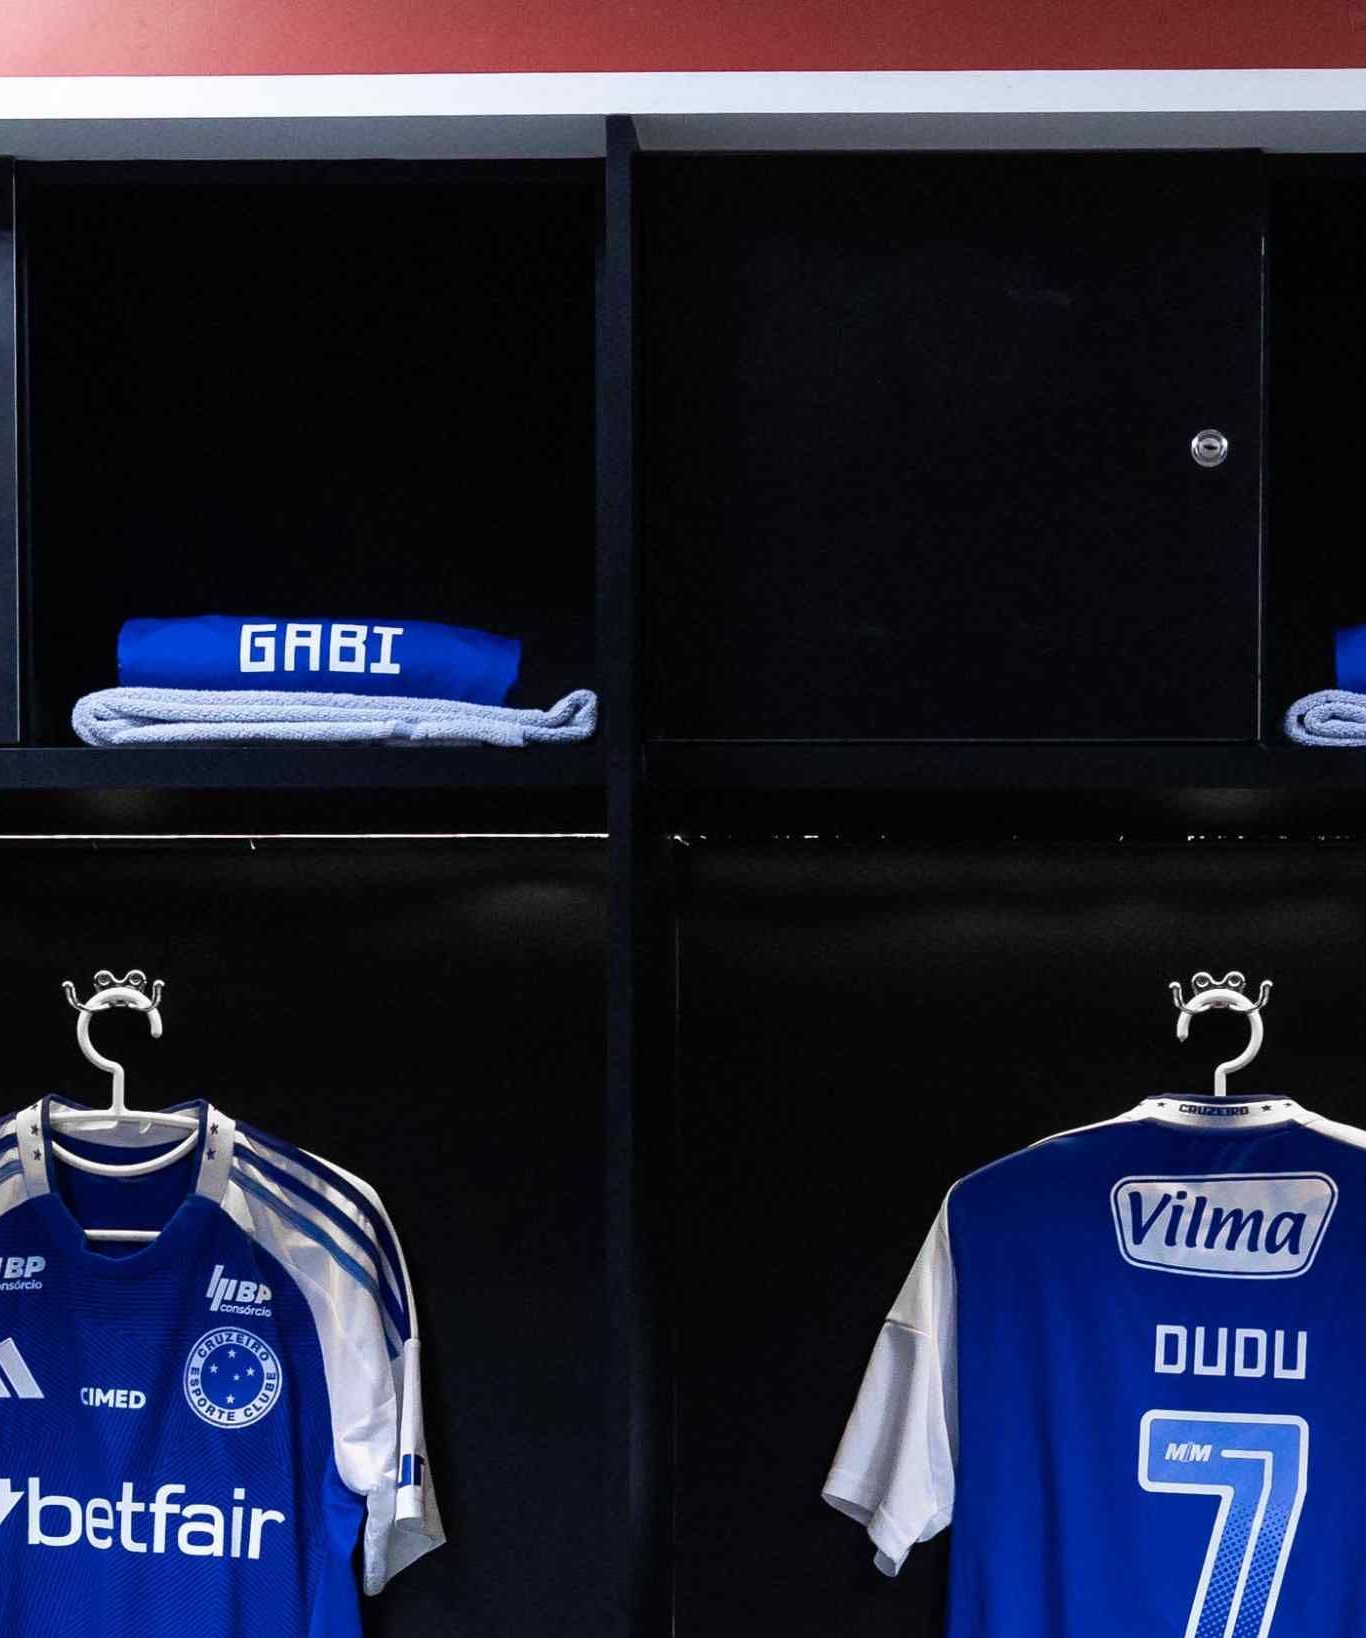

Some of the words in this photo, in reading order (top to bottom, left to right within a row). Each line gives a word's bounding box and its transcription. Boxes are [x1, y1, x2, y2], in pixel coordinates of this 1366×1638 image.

[240, 624, 403, 674] GABI
[1179, 1104, 1249, 1116] CRUZEIRO
[1126, 1191, 1309, 1255] Vilma
[197, 1332, 269, 1362] CRUZEIRO
[1154, 1324, 1308, 1380] DUDU
[190, 1367, 236, 1421] ESPORTE
[243, 1372, 276, 1418] CLUBE
[27, 1477, 286, 1559] betfair
